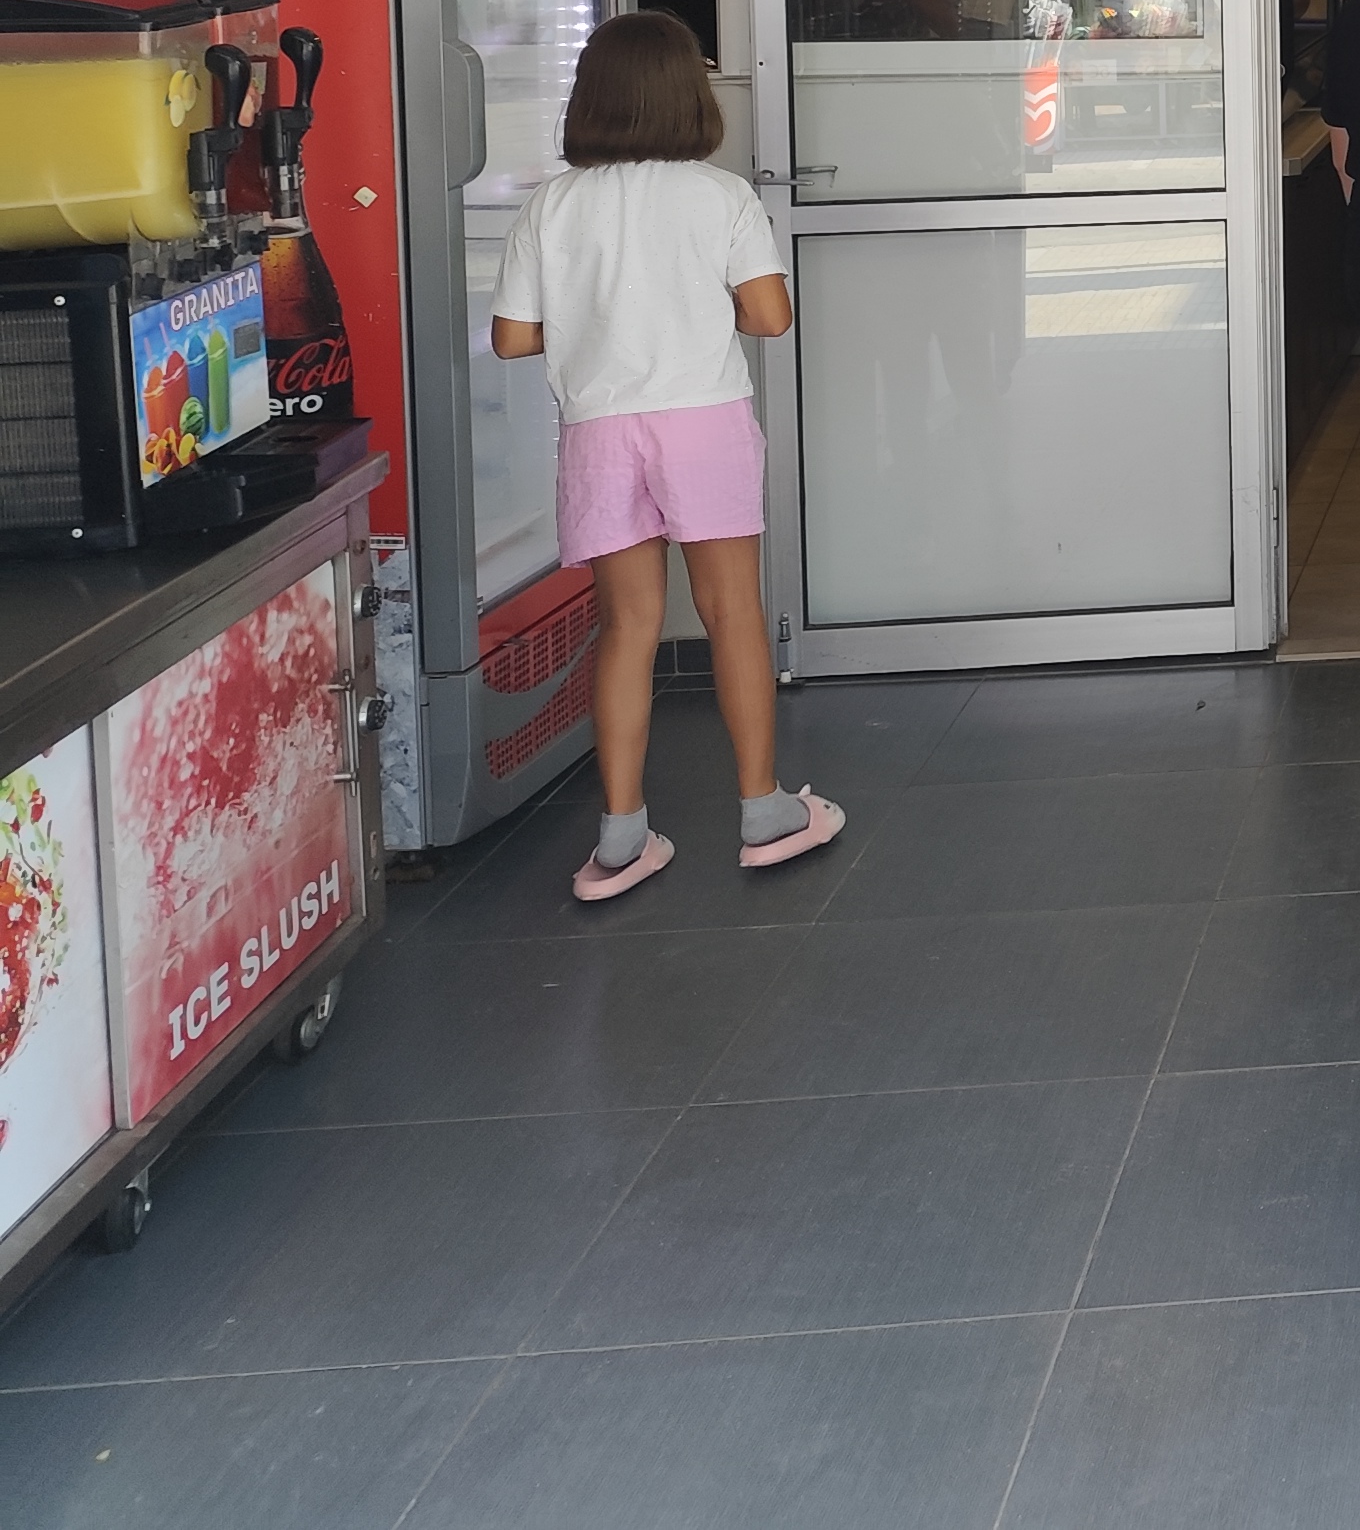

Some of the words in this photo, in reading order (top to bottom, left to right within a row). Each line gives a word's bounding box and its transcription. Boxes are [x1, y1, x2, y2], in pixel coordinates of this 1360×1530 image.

[169, 267, 259, 332] GRANITA
[269, 394, 324, 417] ero
[168, 961, 232, 1061] ICE
[240, 859, 341, 989] SLUSH
